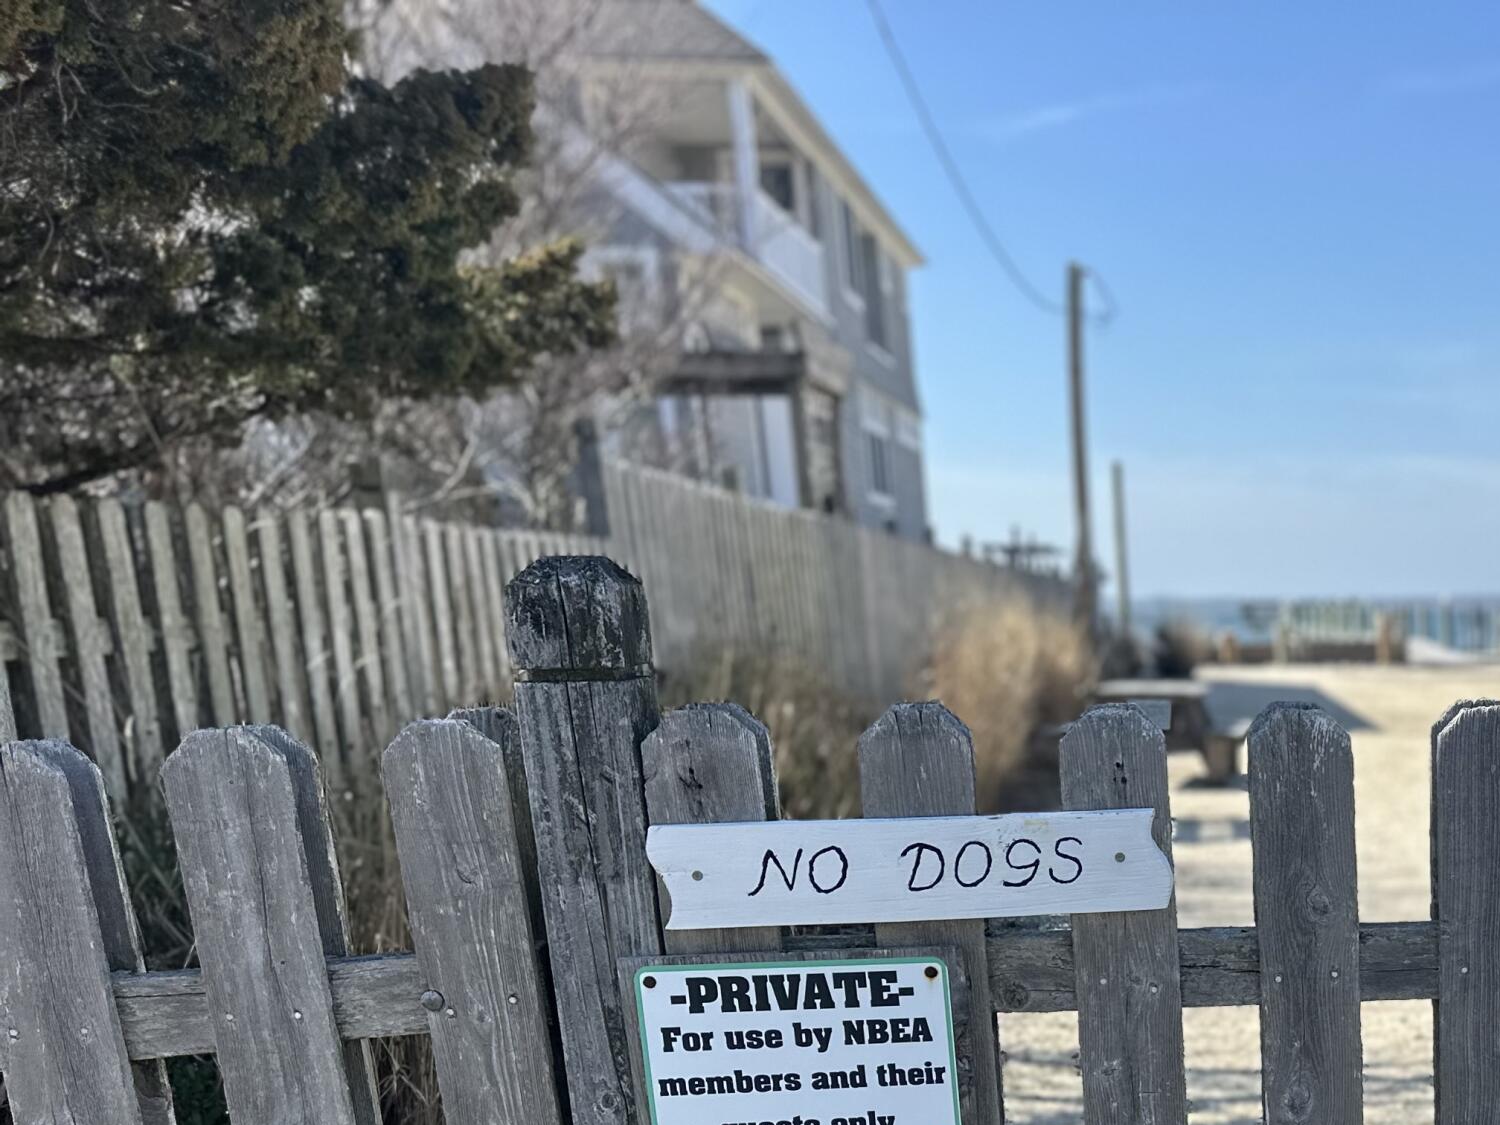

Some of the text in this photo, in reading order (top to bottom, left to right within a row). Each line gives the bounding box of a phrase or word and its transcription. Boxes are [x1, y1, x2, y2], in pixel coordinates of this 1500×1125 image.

[748, 837, 1083, 896] NO DOGS
[670, 971, 915, 1014] -PRIVATE-
[661, 1017, 933, 1053] For use by NBEA
[659, 1061, 946, 1097] members and their
